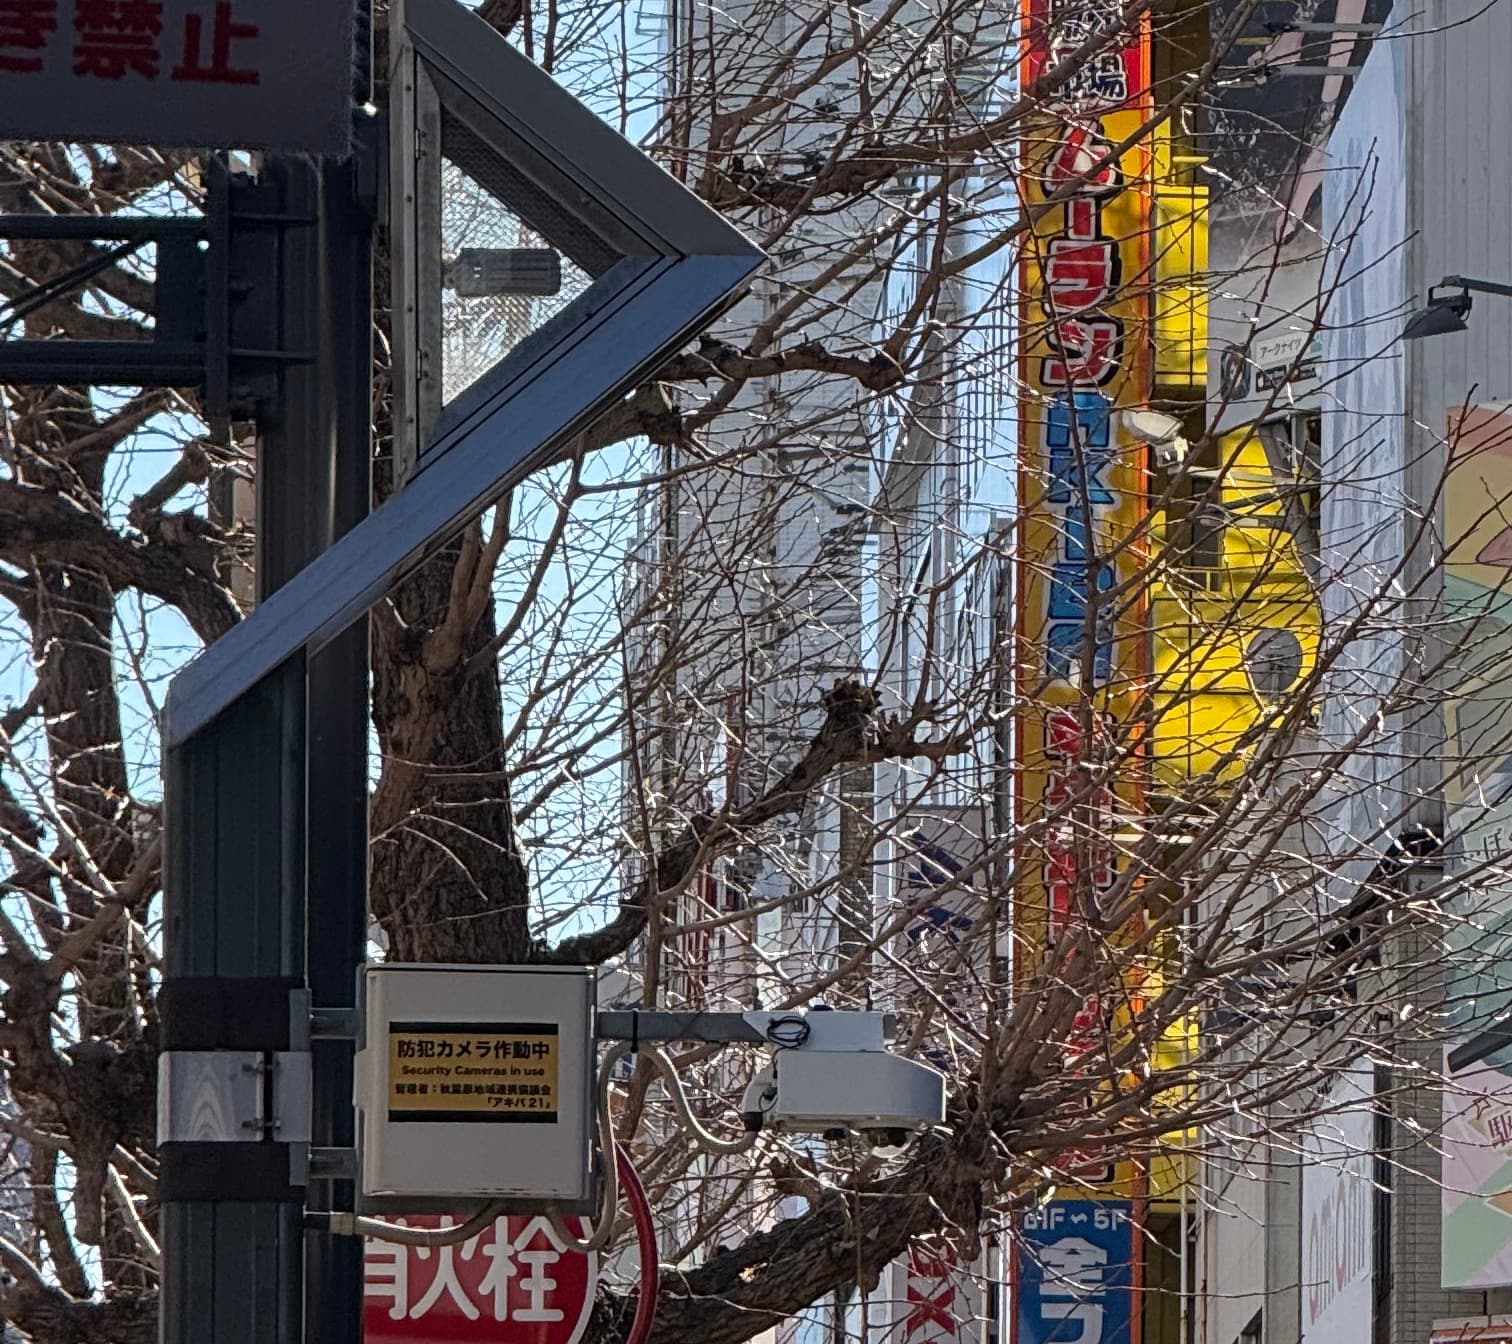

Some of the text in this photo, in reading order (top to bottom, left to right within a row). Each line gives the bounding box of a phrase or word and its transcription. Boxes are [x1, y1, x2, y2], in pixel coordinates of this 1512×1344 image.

[397, 1039, 550, 1060] 防犯カメラ作動中
[402, 1065, 545, 1077] Security Cameras in use
